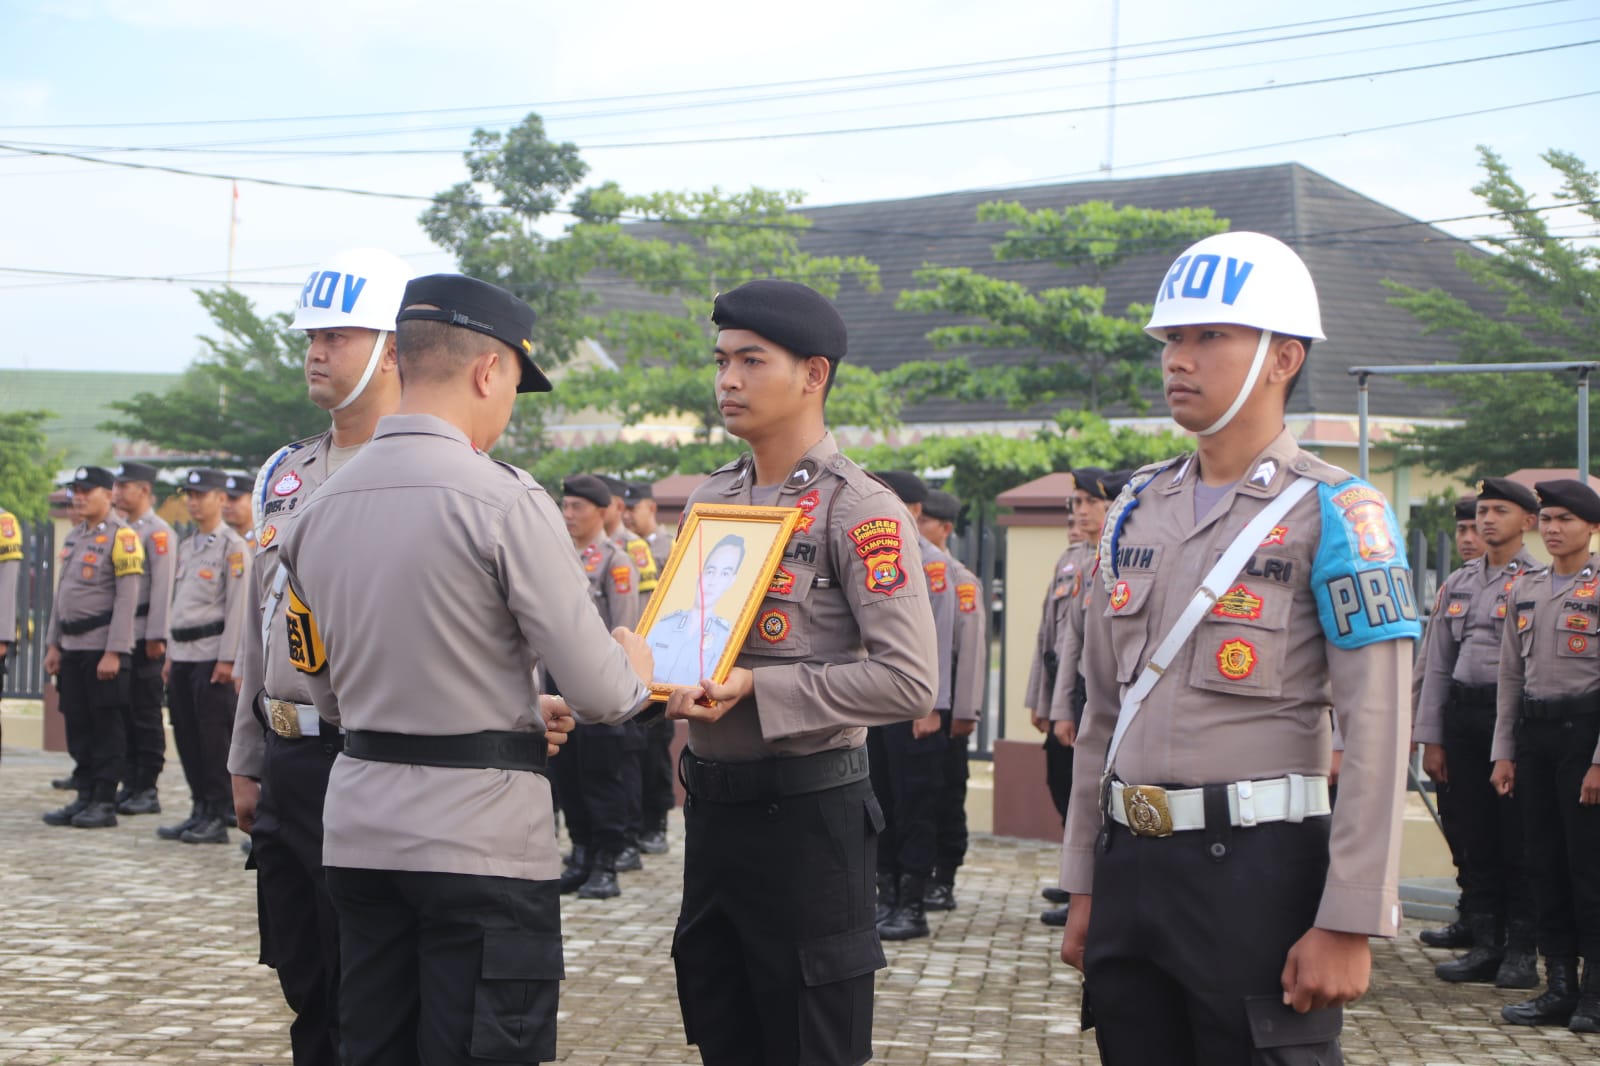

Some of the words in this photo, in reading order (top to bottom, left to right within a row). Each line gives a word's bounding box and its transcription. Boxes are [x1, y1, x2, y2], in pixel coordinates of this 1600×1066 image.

[299, 270, 367, 314] ROV
[1159, 253, 1254, 306] ROV
[854, 520, 896, 536] POLRES
[783, 542, 817, 563] LRI
[861, 538, 899, 553] LAMPUNG
[1243, 555, 1293, 583] LRI
[1328, 567, 1417, 636] PRO
